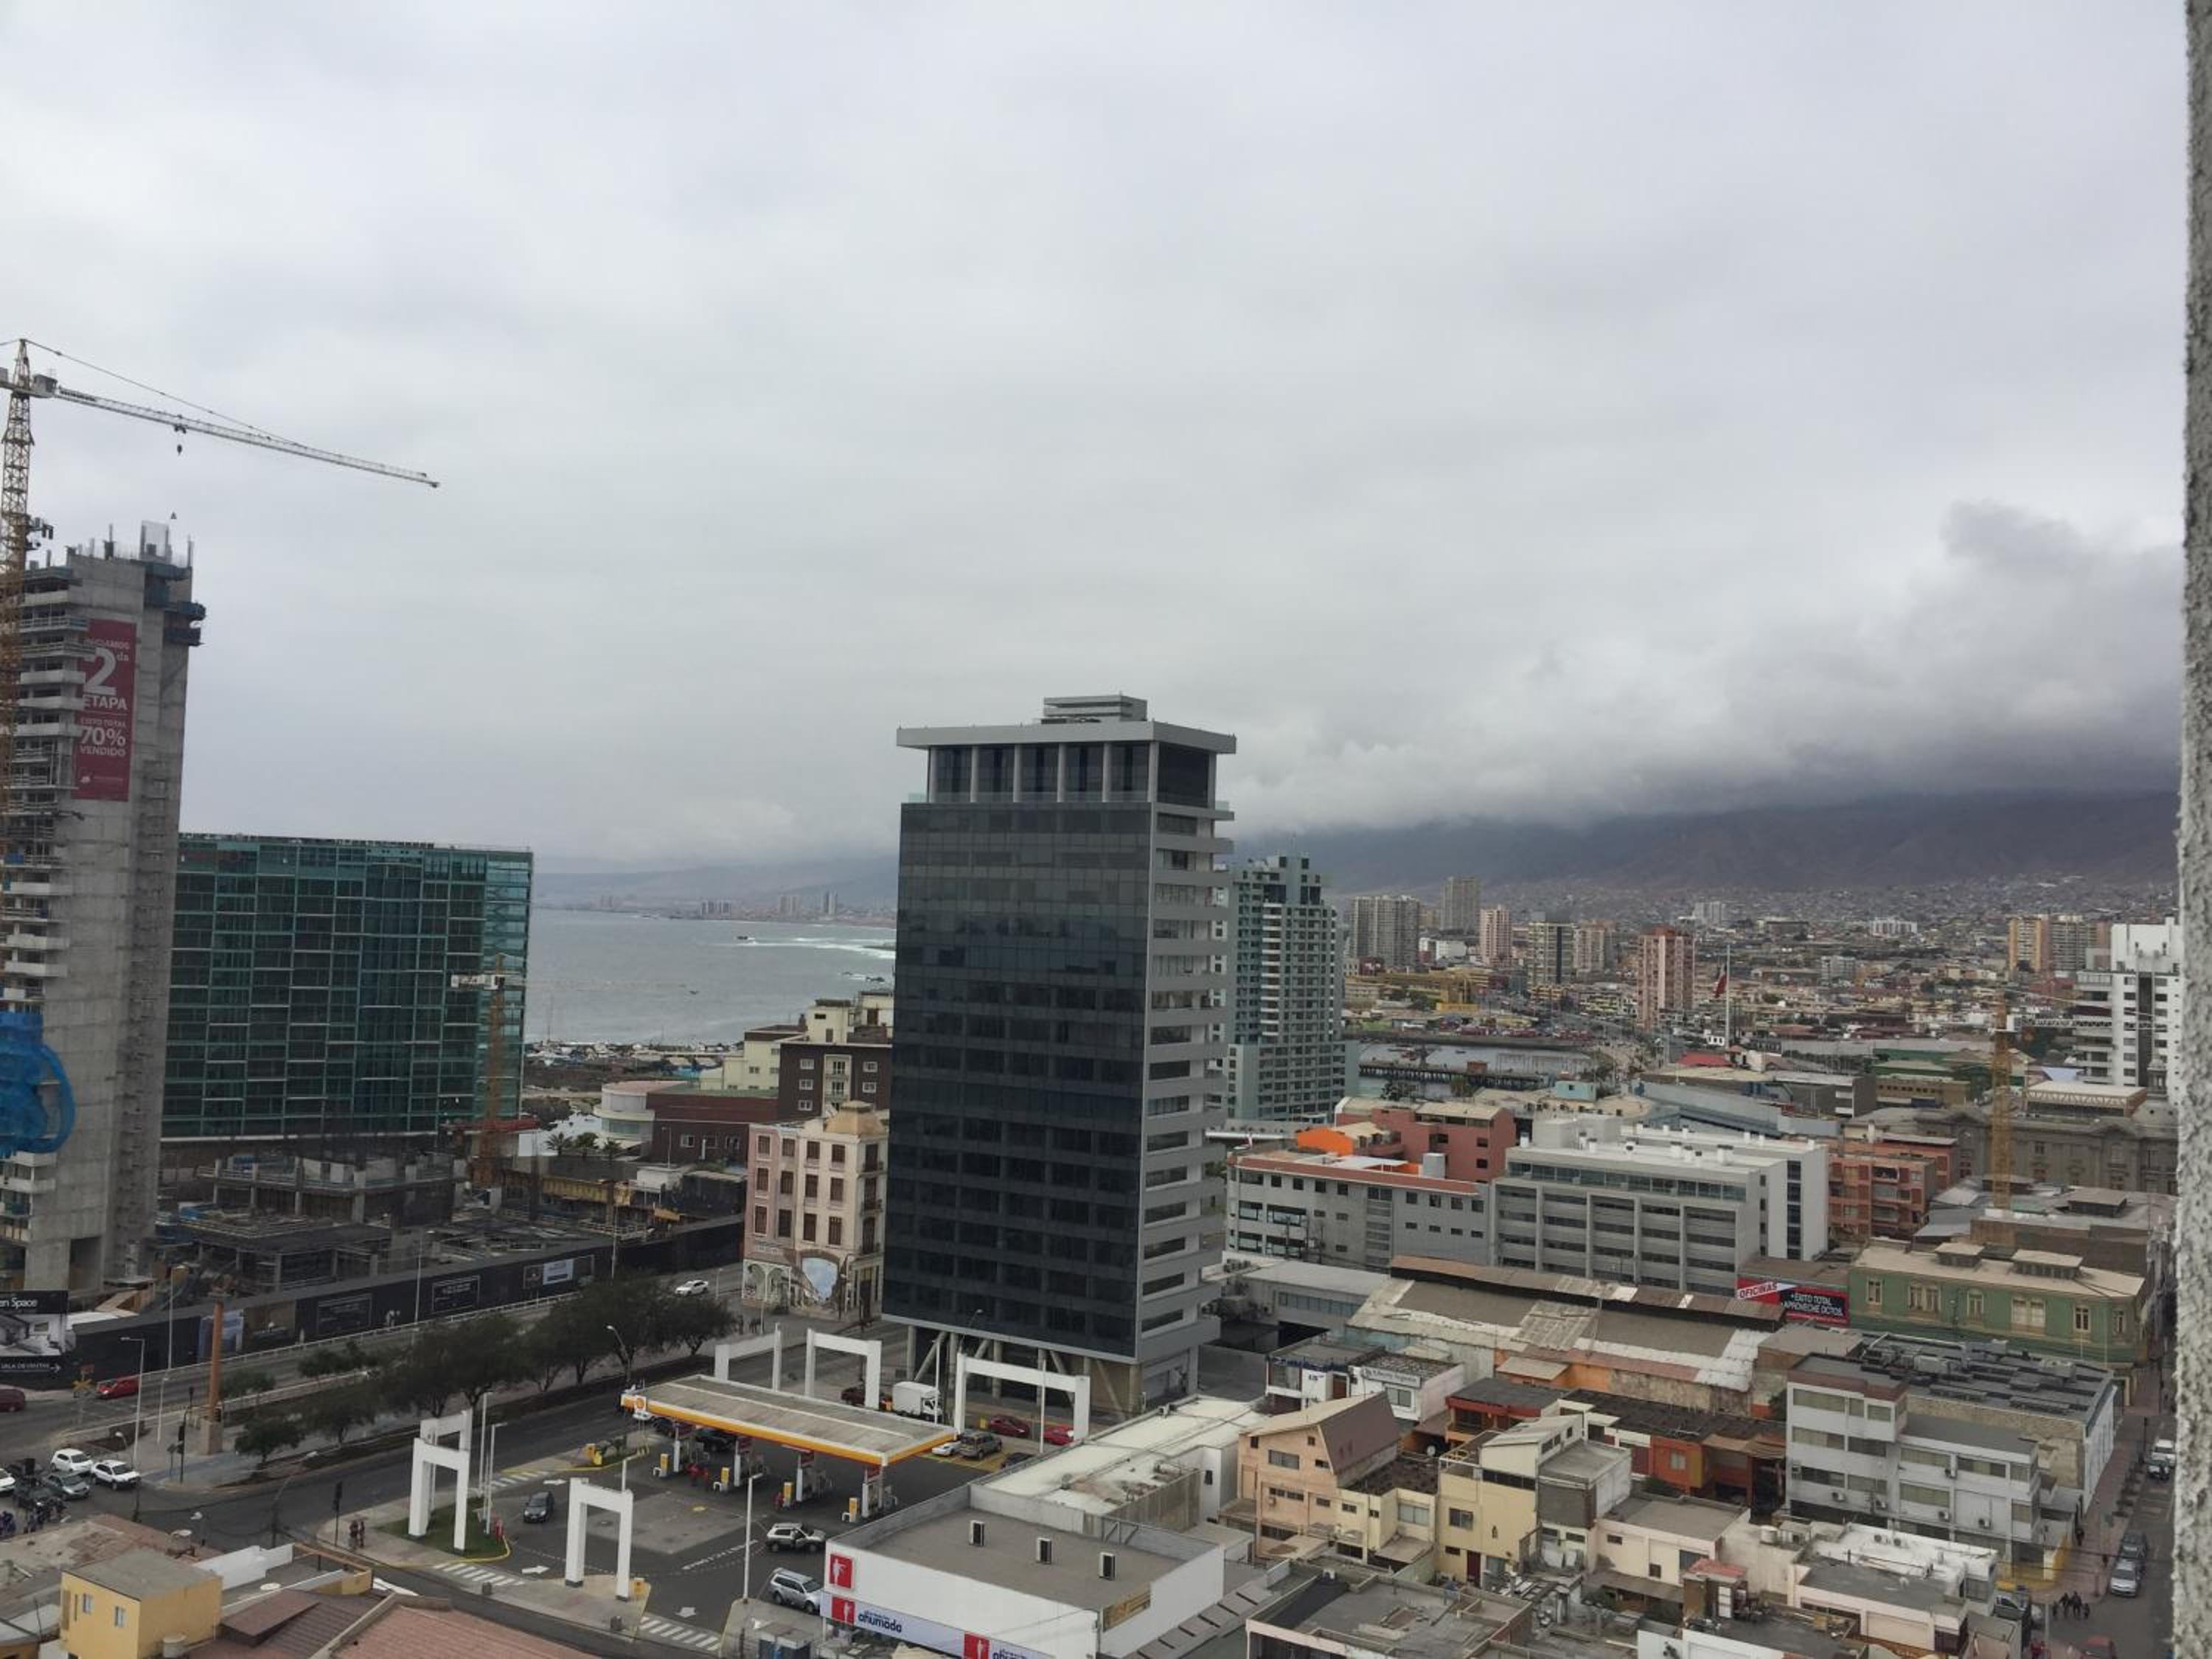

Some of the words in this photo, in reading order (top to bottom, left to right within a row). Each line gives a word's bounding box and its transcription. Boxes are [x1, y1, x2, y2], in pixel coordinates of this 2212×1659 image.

[83, 695, 128, 709] ETAPA
[80, 726, 126, 746] 70%
[80, 745, 126, 757] VENDIDO
[1739, 1281, 1778, 1298] OFICINAS
[12, 1298, 38, 1309] Space
